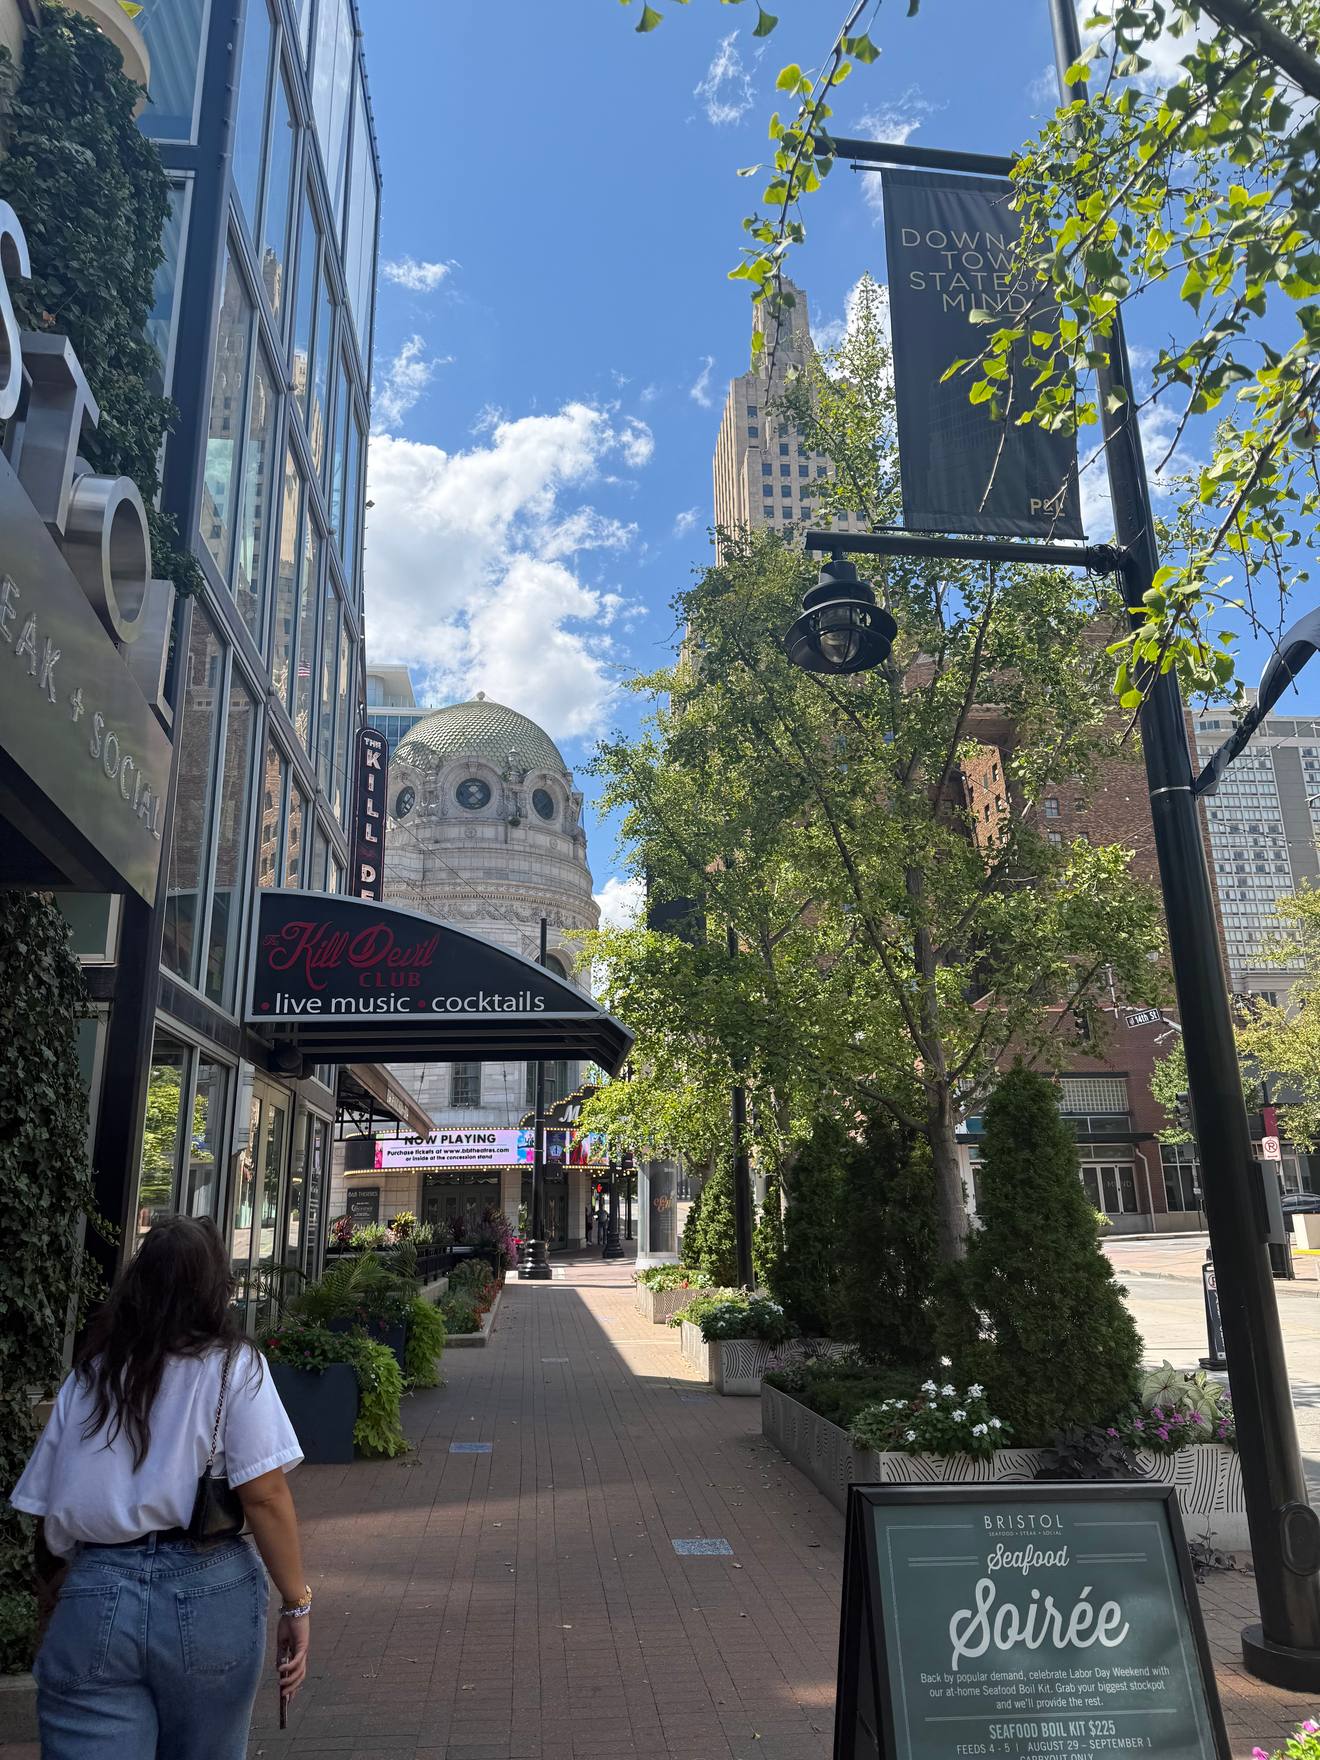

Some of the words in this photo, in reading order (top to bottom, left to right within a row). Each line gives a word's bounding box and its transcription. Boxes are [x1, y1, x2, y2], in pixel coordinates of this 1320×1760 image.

[940, 251, 1016, 269] TOW
[910, 271, 1011, 290] STATE
[943, 293, 1028, 313] MIND
[363, 737, 382, 750] THE
[89, 711, 161, 841] SOCIAL
[364, 749, 382, 843] KILL
[268, 920, 350, 991] Kill
[349, 921, 441, 969] Devil
[359, 971, 421, 988] CLUB
[275, 993, 322, 1014] live
[330, 992, 410, 1013] music
[431, 991, 545, 1012] cocktails
[404, 1134, 438, 1146] NOW
[441, 1133, 496, 1145] PLAYING
[984, 1514, 1064, 1529] BRISTOL
[987, 1543, 1070, 1576] Seafood
[949, 1578, 1130, 1671] Soirée
[920, 1672, 941, 1683] Back
[944, 1673, 956, 1684] by
[957, 1671, 988, 1684] popular
[990, 1669, 1027, 1681] demand,
[1029, 1668, 1067, 1680] celebrate
[1069, 1668, 1092, 1679] Labor
[1094, 1667, 1110, 1679] Day
[1112, 1667, 1150, 1677] Weekend
[1152, 1666, 1170, 1676] with
[929, 1689, 943, 1697] our
[946, 1686, 980, 1697] at-home
[983, 1685, 1017, 1696] Seafood
[1019, 1683, 1035, 1694] Boil
[1038, 1683, 1053, 1693] Kit.
[1055, 1682, 1075, 1693] Grab
[1078, 1684, 1095, 1694] your
[1098, 1681, 1128, 1693] biggest
[1129, 1680, 1165, 1692] stockpot
[996, 1699, 1012, 1709] and
[1014, 1698, 1034, 1709] we'll
[1036, 1697, 1067, 1709] provide
[1069, 1697, 1083, 1706] the
[1085, 1696, 1104, 1706] rest.
[989, 1723, 1038, 1740] SEAFOOD
[1041, 1722, 1067, 1737] BOIL
[1069, 1721, 1086, 1736] KIT
[1088, 1719, 1116, 1737] $225
[956, 1743, 987, 1754] FEEDS
[989, 1743, 995, 1753] 4
[1004, 1743, 1011, 1753] 5
[1028, 1740, 1064, 1752] AUGUST
[1067, 1740, 1079, 1750] 29
[1089, 1737, 1144, 1749] SEPTEMBER
[1146, 1736, 1152, 1747] 1
